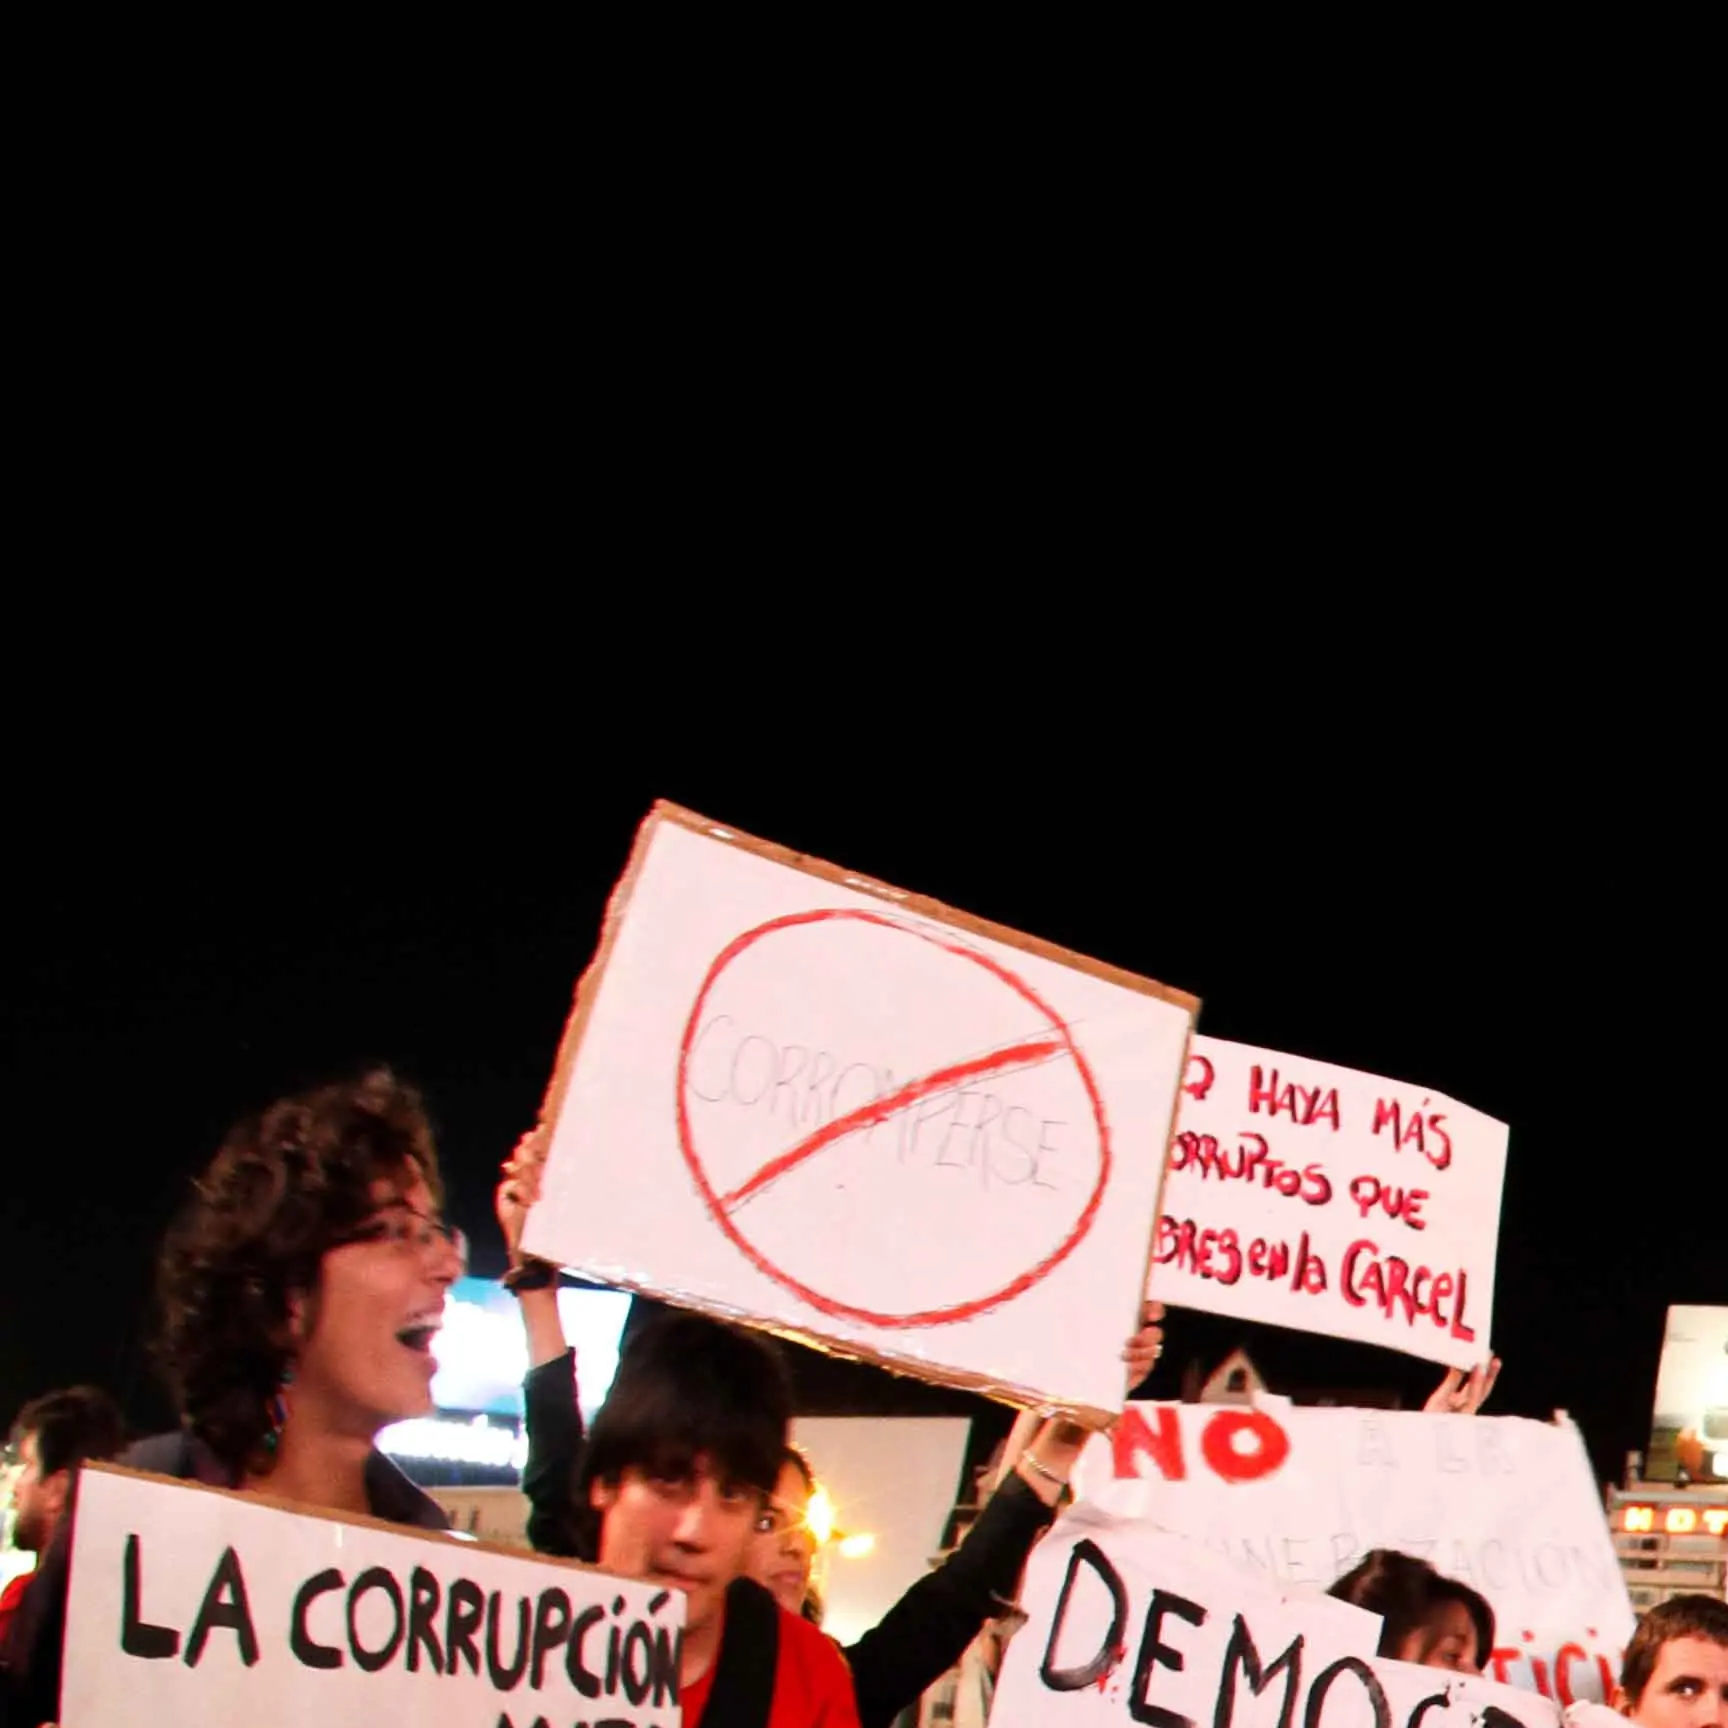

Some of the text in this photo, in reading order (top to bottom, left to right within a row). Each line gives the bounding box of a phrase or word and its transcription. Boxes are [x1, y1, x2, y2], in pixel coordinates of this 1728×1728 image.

[1250, 1064, 1341, 1132] HAYA
[1372, 1097, 1454, 1171] MÁS
[1169, 1130, 1431, 1231] ORRUPTOS QUE
[1152, 1213, 1244, 1286] BRES
[1112, 1403, 1291, 1487] NO
[120, 1534, 684, 1707] LA CORRUPCIÓN
